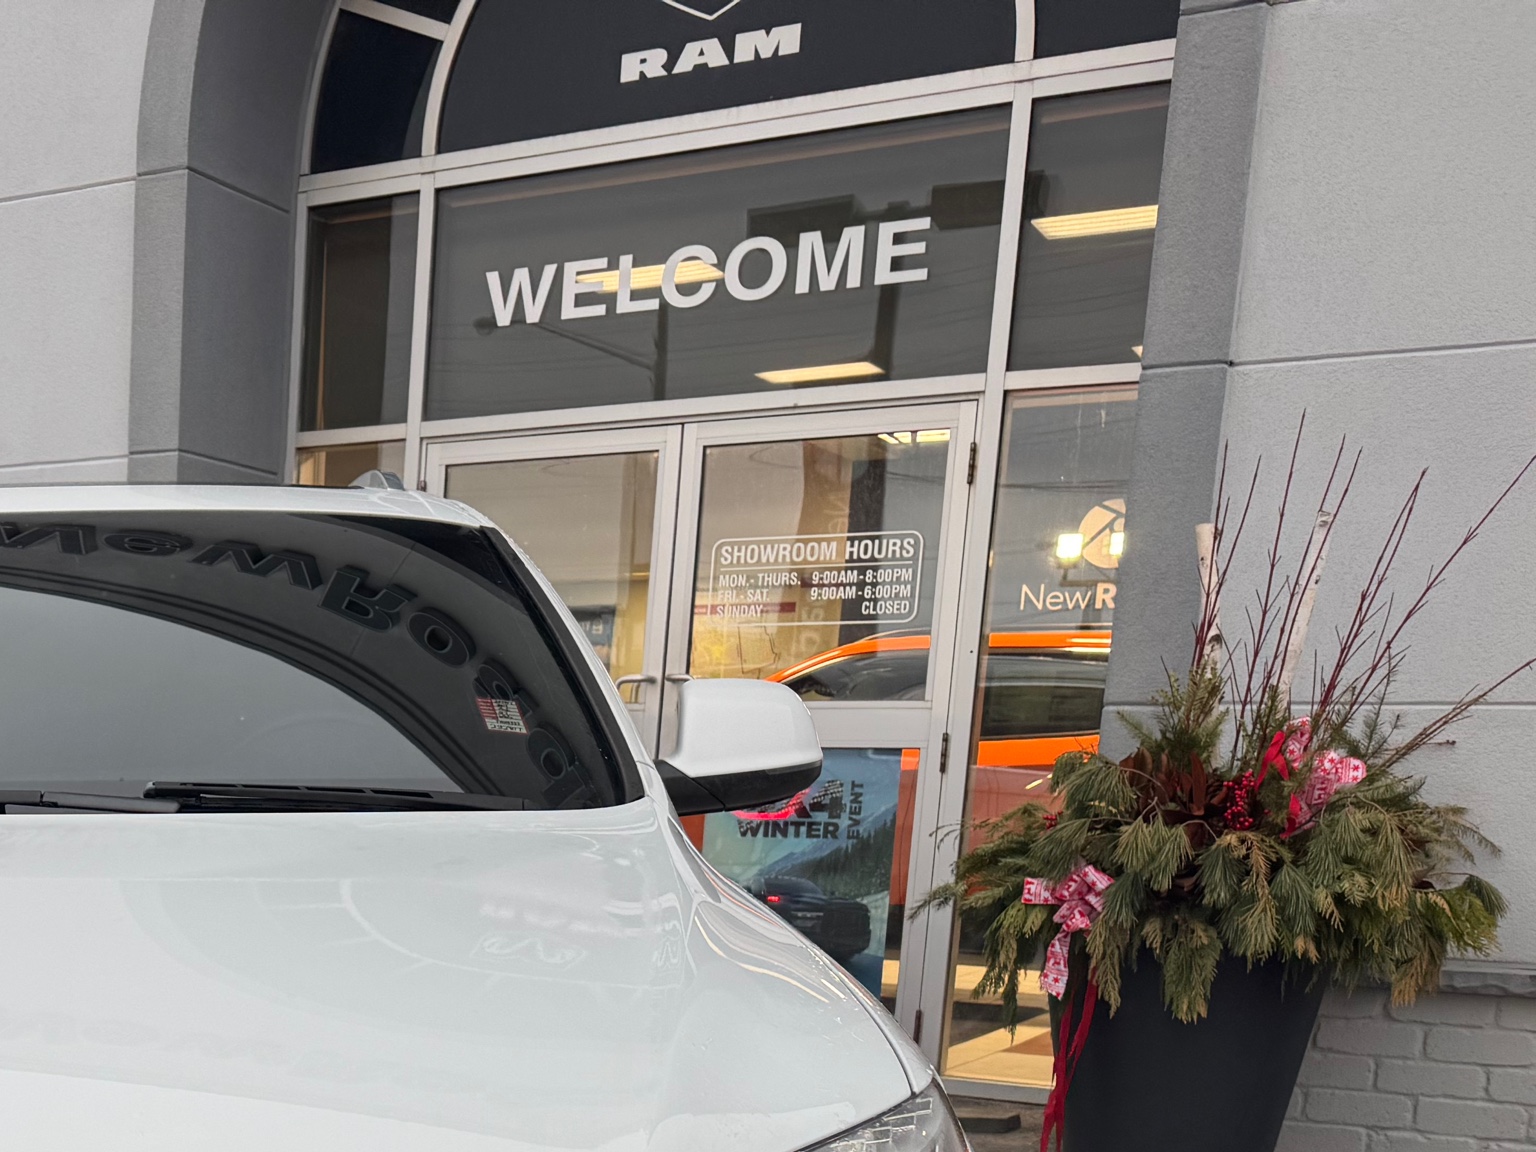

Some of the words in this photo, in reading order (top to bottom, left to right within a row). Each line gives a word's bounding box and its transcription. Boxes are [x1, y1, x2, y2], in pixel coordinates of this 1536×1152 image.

[619, 22, 802, 84] RAM
[485, 216, 932, 327] WELCOME
[720, 541, 837, 565] SHOWROOM
[845, 538, 915, 560] HOURS
[716, 604, 763, 618] SUNDAY
[861, 600, 910, 615] CLOSED
[737, 819, 840, 839] WINTER
[847, 780, 864, 840] EVENT
